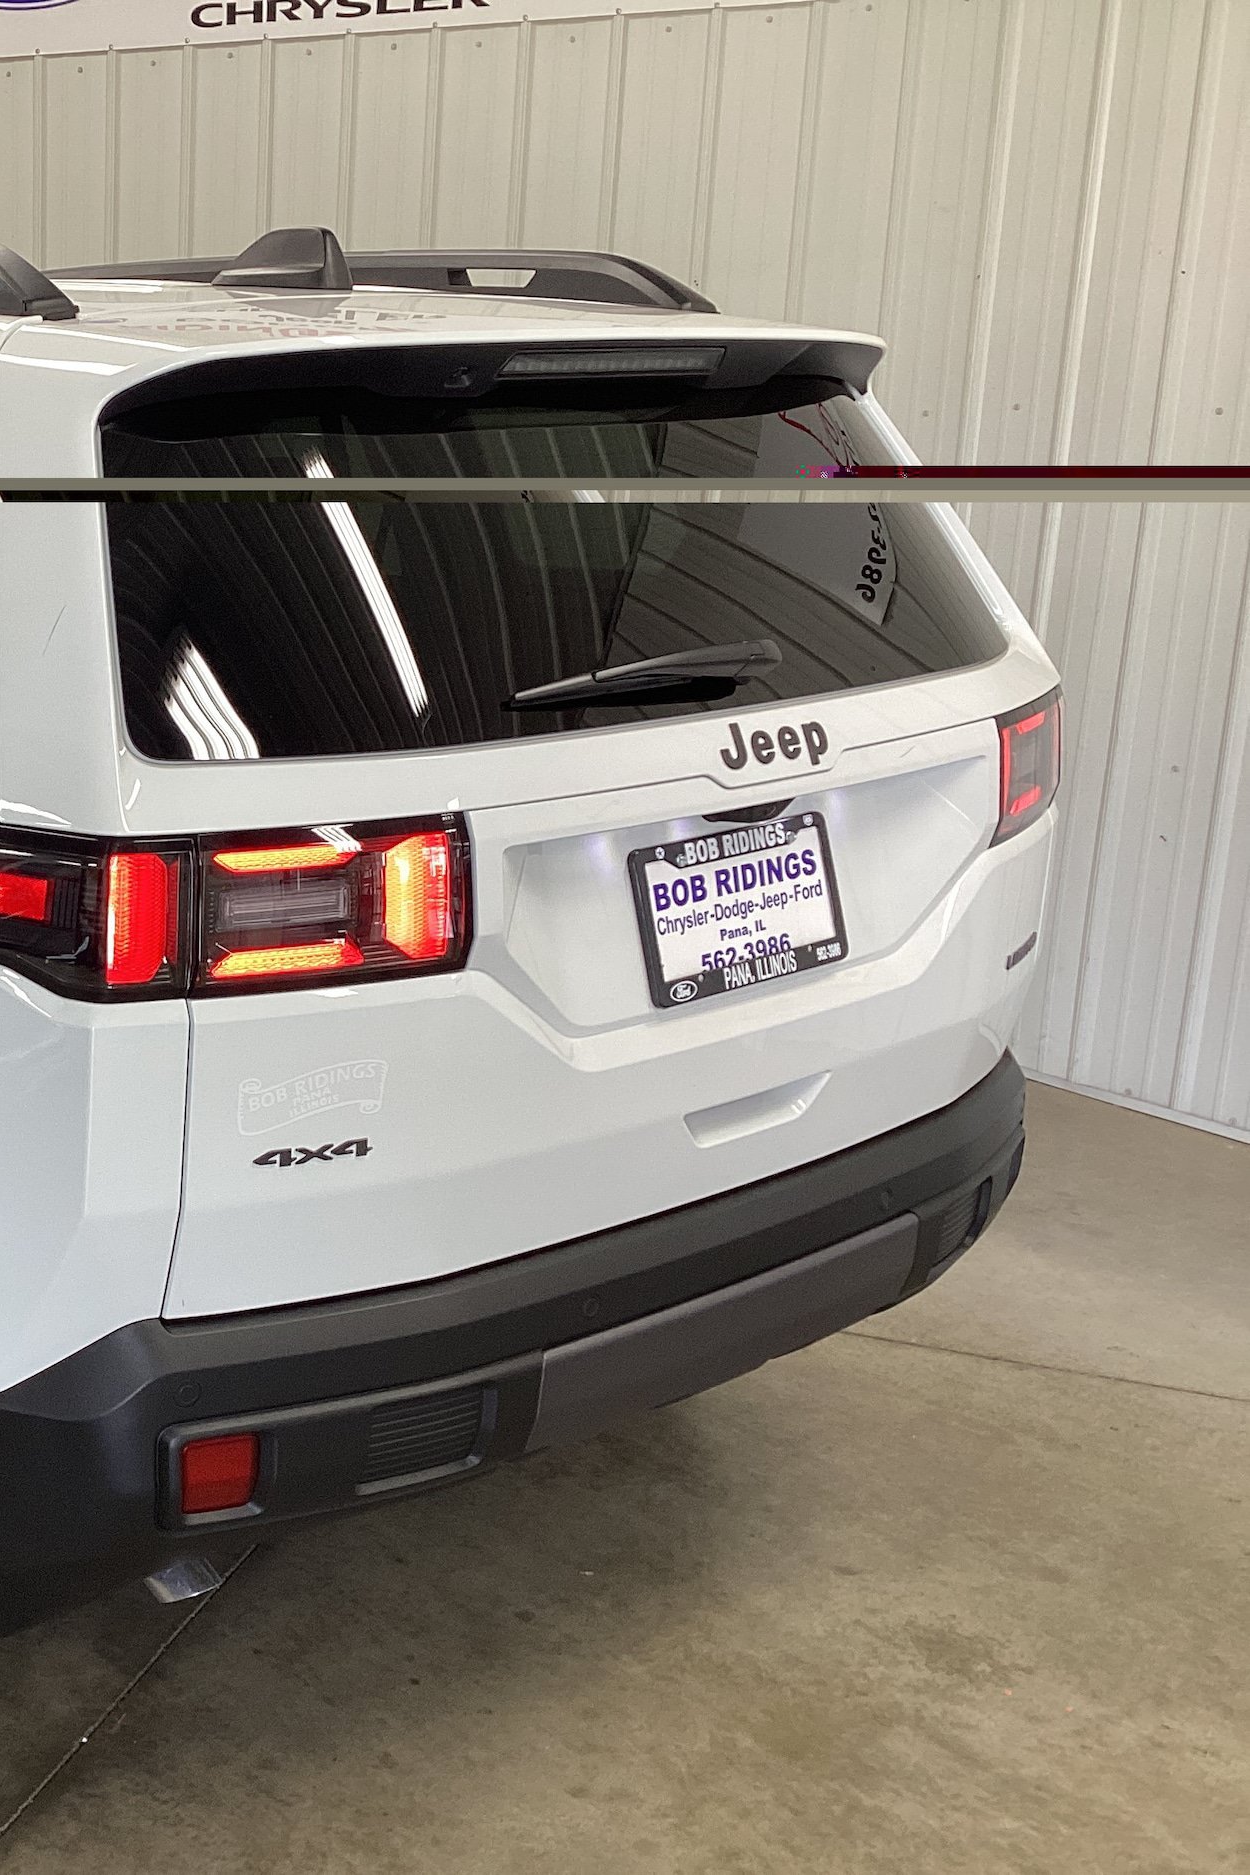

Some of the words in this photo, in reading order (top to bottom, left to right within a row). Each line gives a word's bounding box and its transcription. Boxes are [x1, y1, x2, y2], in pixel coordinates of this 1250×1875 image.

[720, 721, 829, 770] Jeep
[684, 837, 720, 866] BOB
[722, 822, 786, 857] RIDINGS
[652, 874, 708, 912] BOB
[714, 849, 817, 897] RIDINGS
[656, 879, 823, 936] Chrysler-Dodge-Jeep-Ford
[720, 924, 752, 941] Pana,
[754, 919, 767, 932] IL
[701, 932, 792, 972] 562-3986
[755, 949, 798, 981] ILLINOIS
[249, 1087, 288, 1113] BOB
[295, 1063, 376, 1095] RIDINGS
